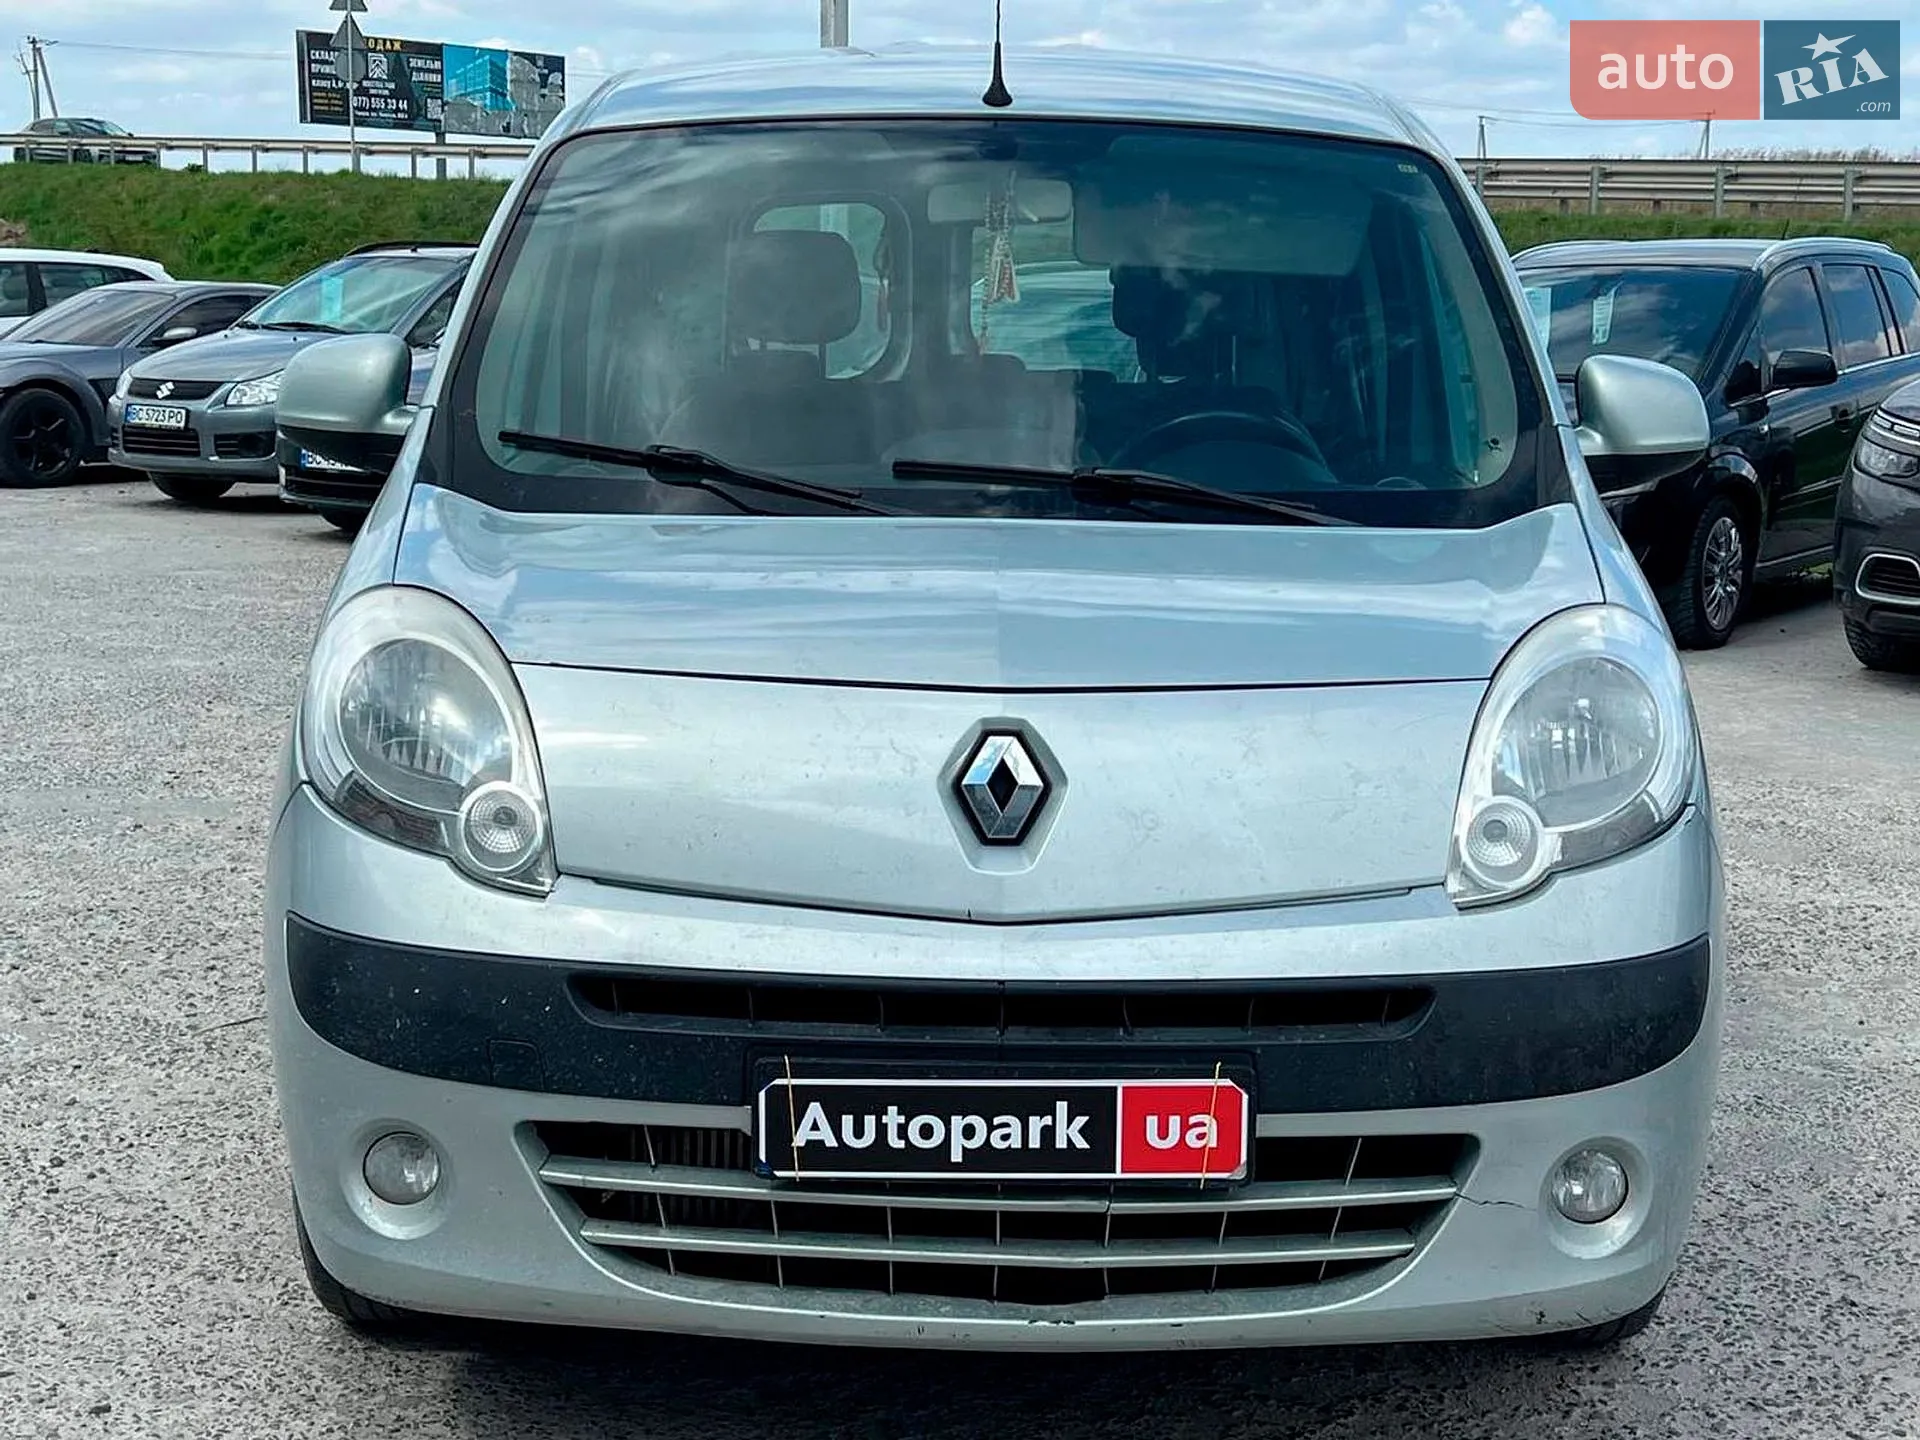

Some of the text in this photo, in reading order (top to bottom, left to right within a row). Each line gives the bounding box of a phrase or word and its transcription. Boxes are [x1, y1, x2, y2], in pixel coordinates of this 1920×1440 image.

[366, 40, 402, 51] ОДАЖ
[310, 50, 339, 62] СКЛАД
[352, 96, 370, 108] 077)
[793, 1102, 1219, 1162] Autopark ua
